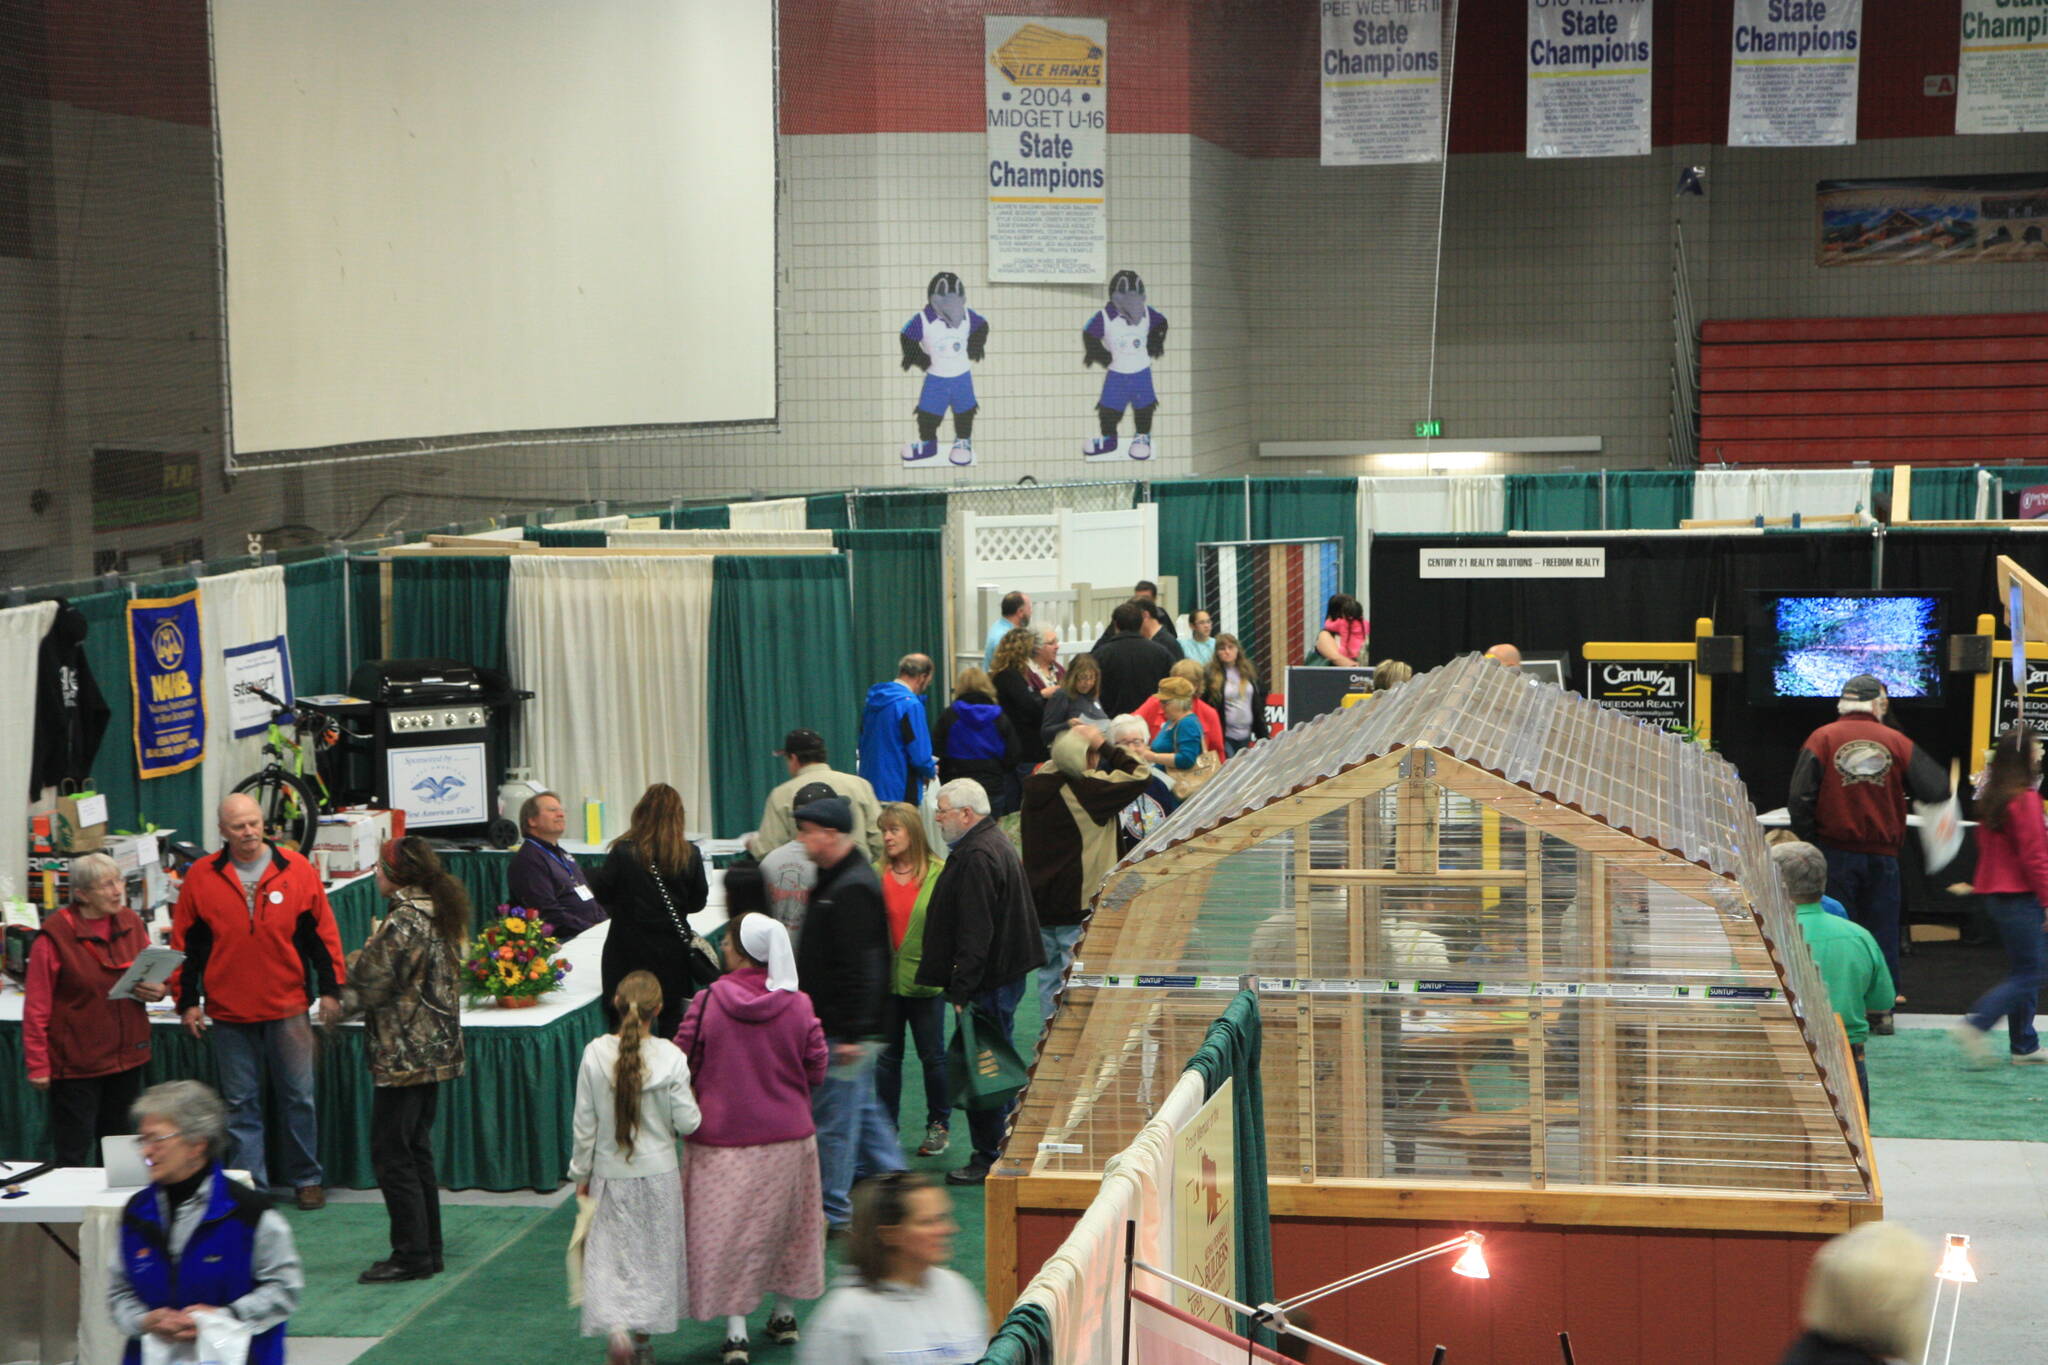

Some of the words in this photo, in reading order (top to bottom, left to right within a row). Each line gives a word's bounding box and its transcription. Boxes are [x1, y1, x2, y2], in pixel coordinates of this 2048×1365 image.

[1562, 9, 1618, 36] State
[1768, 0, 1826, 22] State
[1353, 19, 1408, 46] State
[1735, 24, 1857, 56] Champions
[1324, 48, 1439, 77] Champions
[1530, 37, 1649, 69] Champions
[1019, 63, 1045, 77] ICE
[1049, 64, 1101, 77] HAWKS
[1019, 87, 1073, 107] 2004
[988, 109, 1064, 127] MIDGET
[1069, 111, 1105, 128] U-16
[1019, 130, 1073, 158] State
[990, 160, 1104, 192] Champions
[1427, 558, 1456, 567] CENTURY
[1459, 558, 1467, 567] 21
[1470, 558, 1494, 567] REALTY
[1496, 558, 1532, 567] SOLUTIONS
[1542, 557, 1573, 567] FREEDOM
[1575, 557, 1600, 567] REALTY
[1603, 664, 1663, 685] Century
[1657, 677, 1675, 696] 21
[1600, 700, 1644, 708] REEDOM
[1646, 700, 1684, 708] REALTY
[2004, 699, 2048, 710] FREDO
